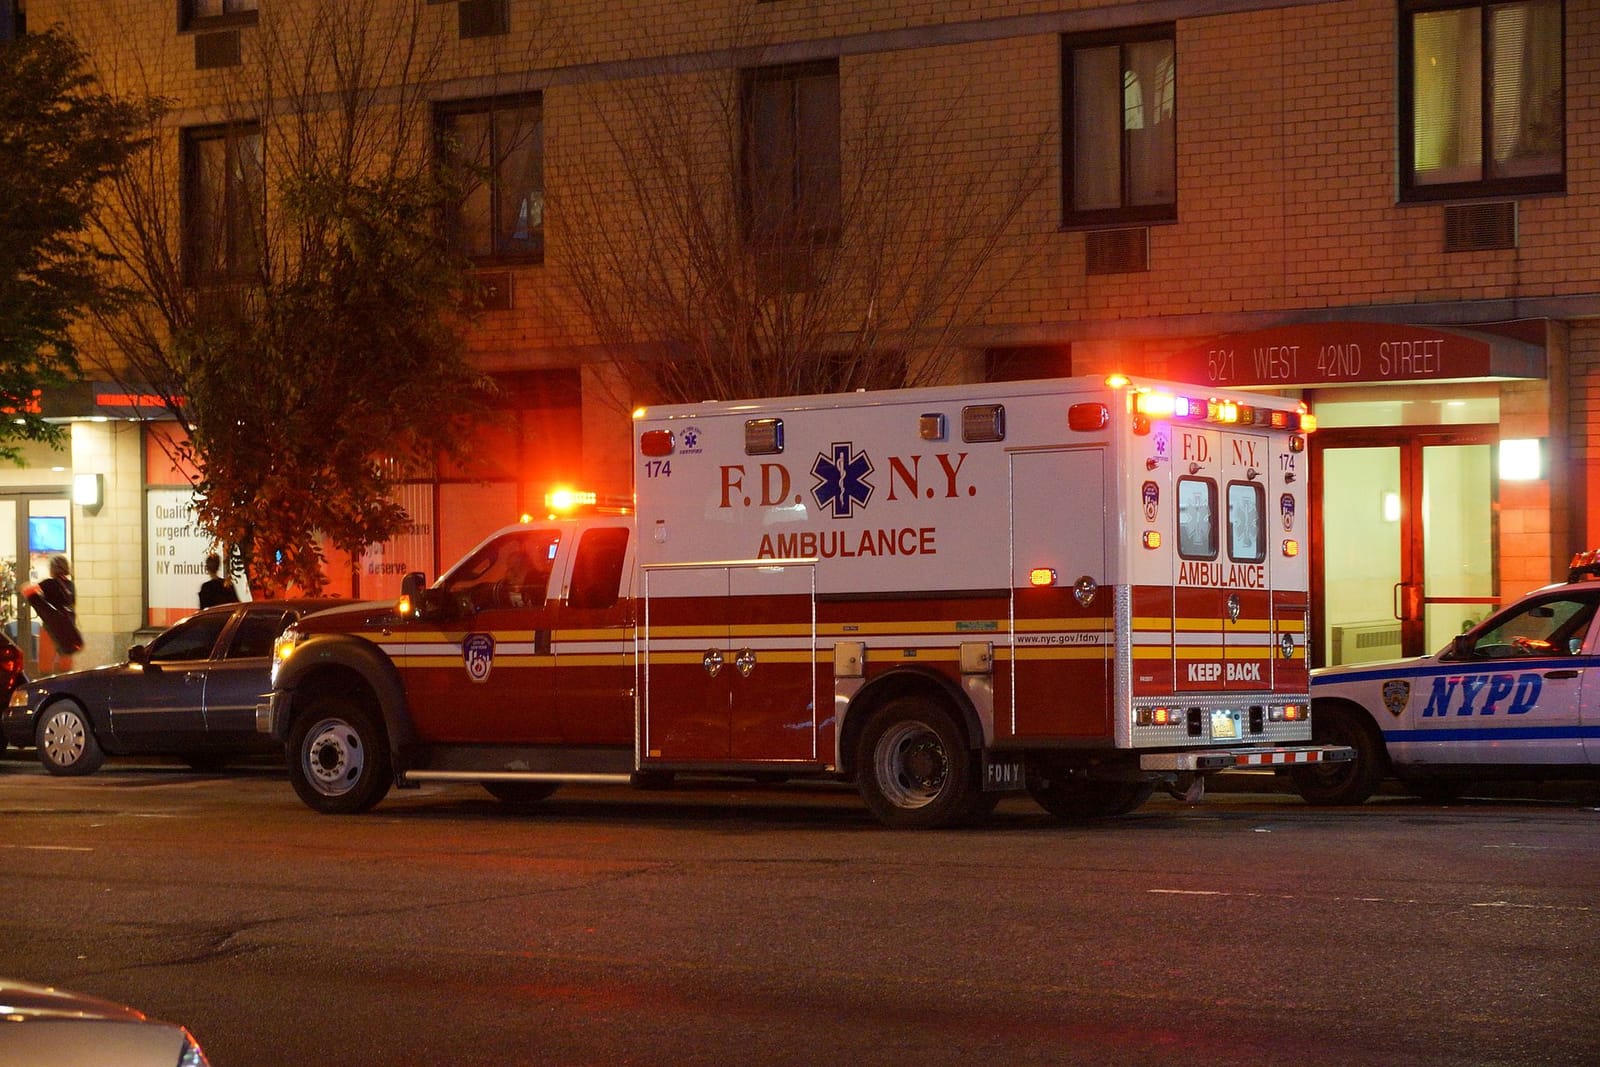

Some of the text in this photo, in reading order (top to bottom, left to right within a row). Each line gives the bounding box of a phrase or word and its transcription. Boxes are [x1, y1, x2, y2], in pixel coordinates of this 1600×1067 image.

[1208, 339, 1444, 381] 521 WEST 42ND STREET
[1183, 434, 1260, 467] F.D. N.Y.
[645, 460, 671, 478] 174
[1279, 453, 1295, 471] 174
[719, 453, 976, 508] F.D. N.Y.
[156, 505, 192, 521] Quality
[156, 525, 190, 540] urgent
[156, 543, 175, 556] in a
[757, 527, 937, 560] AMBULANCE
[156, 561, 170, 575] NY
[368, 562, 407, 575] deserve
[1179, 562, 1264, 588] AMBULANCE
[1017, 634, 1099, 645] www.nyc.gov/fdny
[1188, 663, 1260, 682] KEEP BACK
[1422, 673, 1542, 717] NYPD
